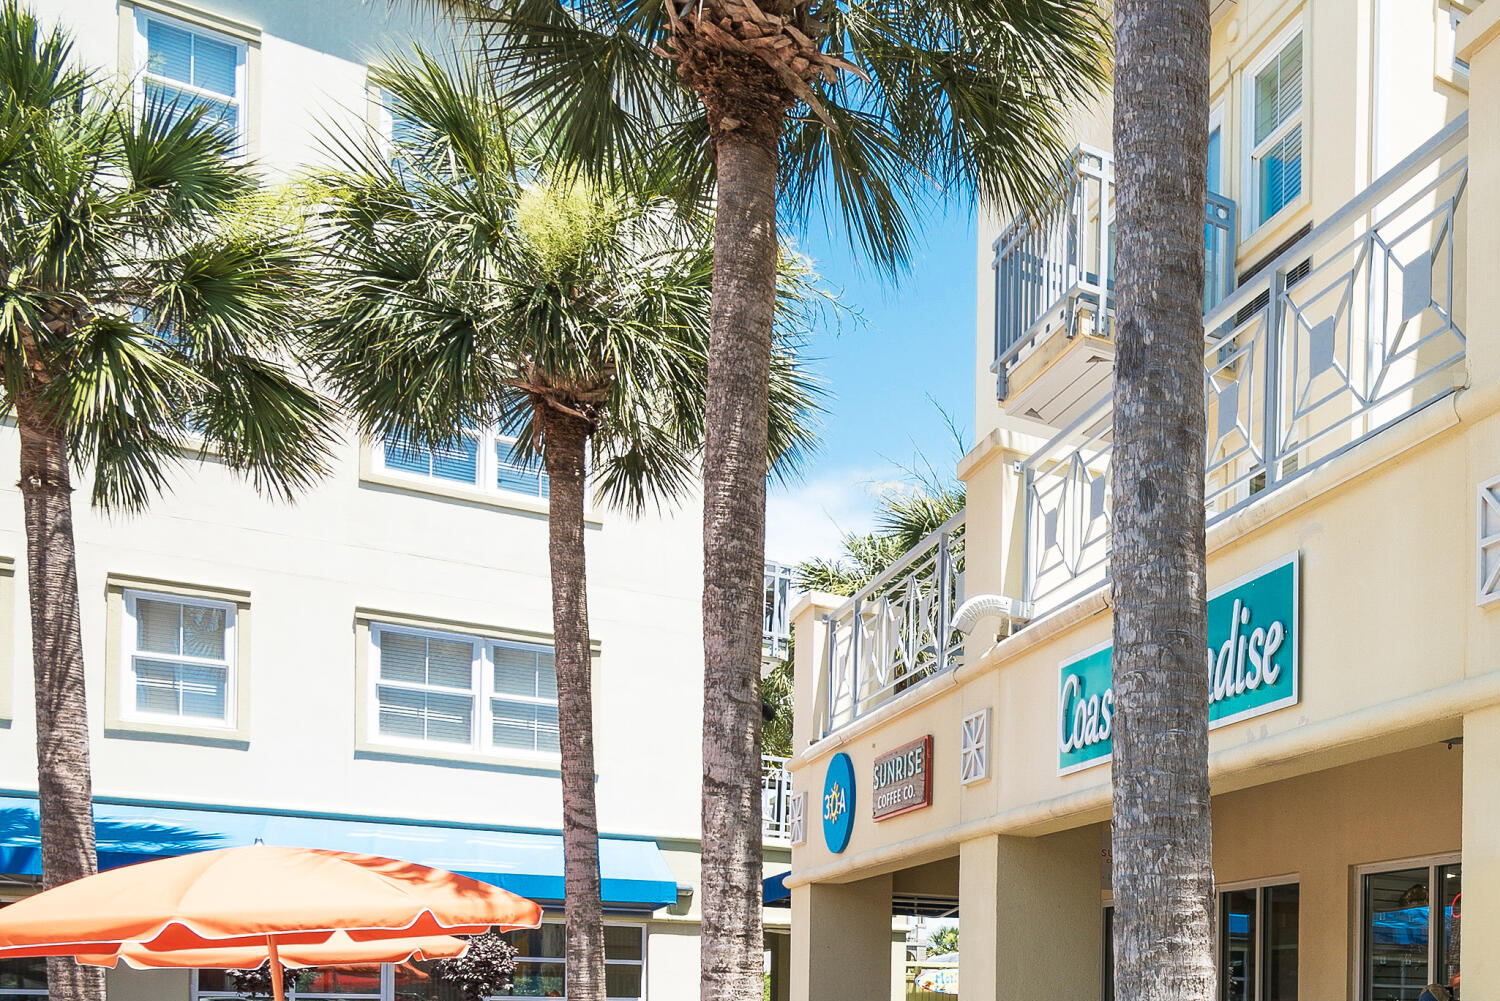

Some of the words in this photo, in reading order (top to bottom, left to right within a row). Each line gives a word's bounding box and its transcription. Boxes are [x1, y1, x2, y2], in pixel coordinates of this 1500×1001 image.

[873, 747, 924, 790] SUNRISE
[877, 789, 902, 809] COFFEE
[903, 784, 917, 800] CO.
